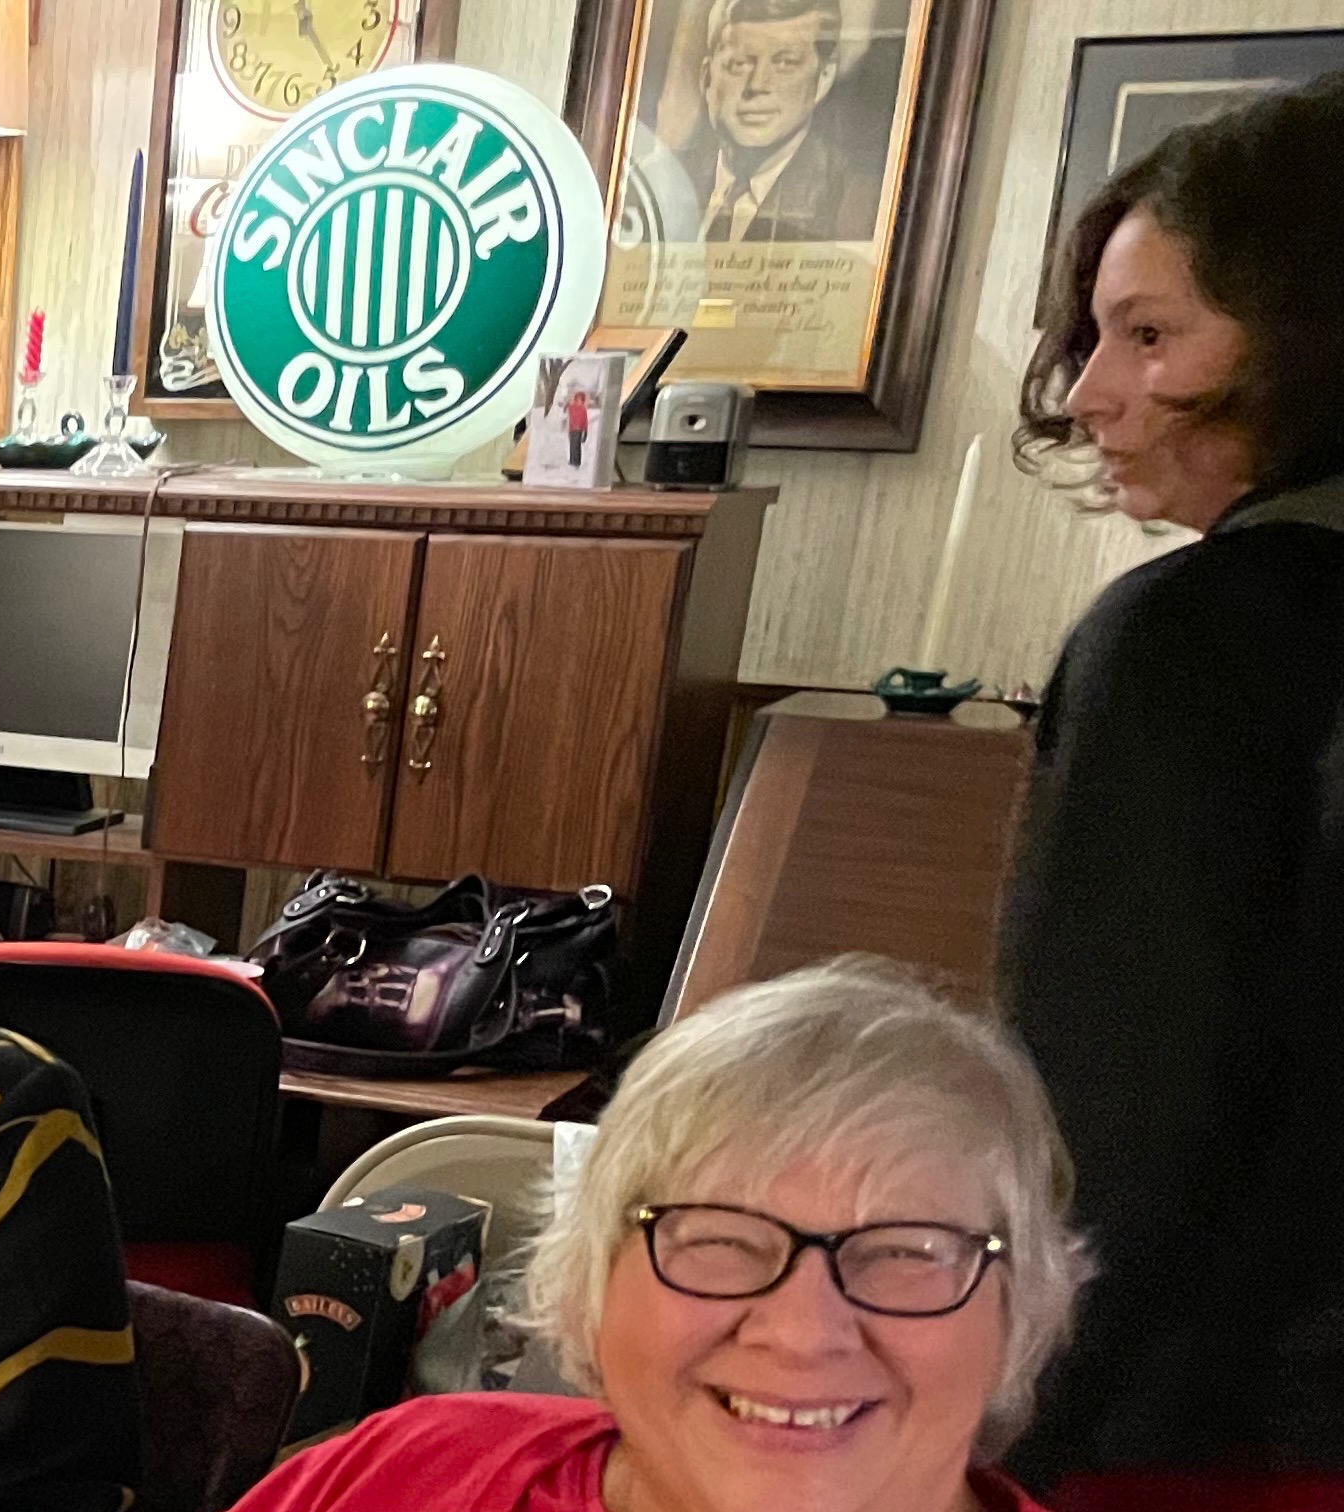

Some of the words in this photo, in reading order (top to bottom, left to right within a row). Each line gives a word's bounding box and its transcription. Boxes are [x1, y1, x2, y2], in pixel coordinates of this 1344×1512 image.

[222, 4, 241, 39] 9
[361, 0, 381, 31] 3
[229, 41, 248, 73] 8
[345, 36, 364, 68] 4
[254, 60, 273, 97] 7
[283, 72, 303, 107] 6
[232, 101, 542, 272] SINCLAIR
[278, 345, 466, 434] OILS
